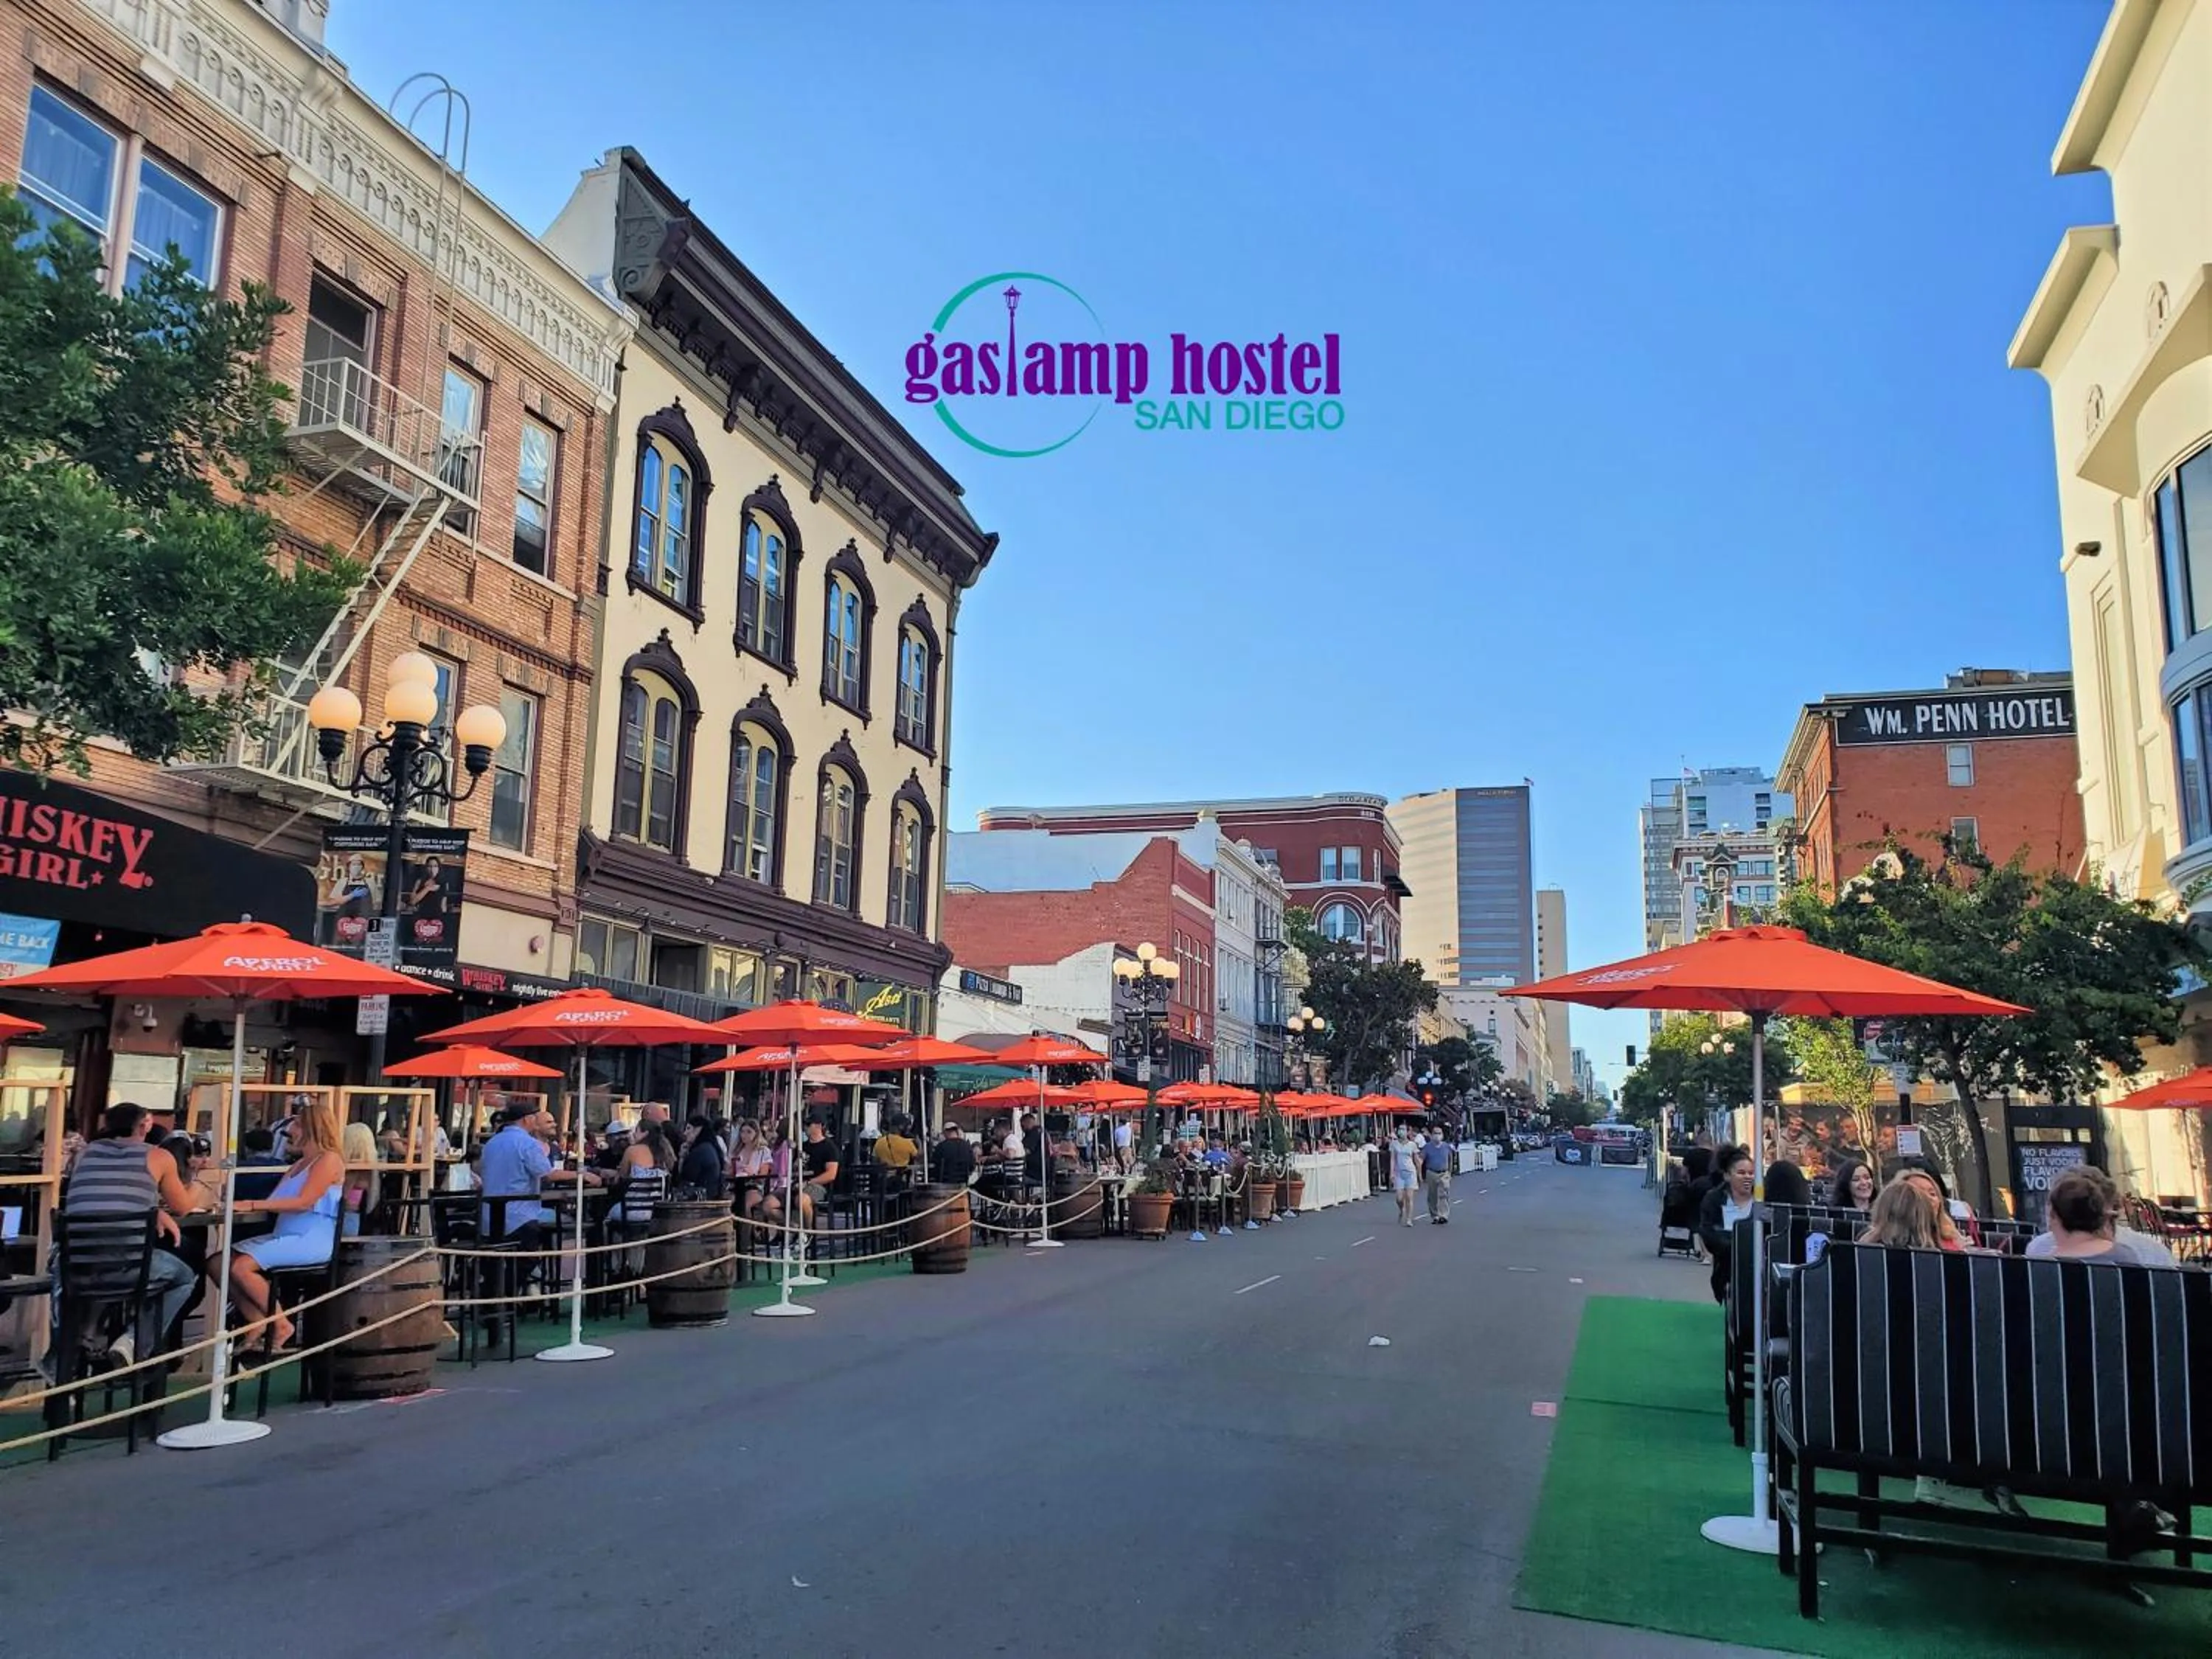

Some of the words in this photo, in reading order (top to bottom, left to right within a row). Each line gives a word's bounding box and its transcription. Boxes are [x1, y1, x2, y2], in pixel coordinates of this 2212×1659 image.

[1916, 702, 1978, 734] PENN
[1988, 698, 2070, 730] HOTEL
[433, 967, 455, 981] drink
[512, 983, 536, 998] nightly
[536, 986, 549, 997] live
[2021, 1147, 2036, 1157] NO
[2023, 1158, 2045, 1166] JUST
